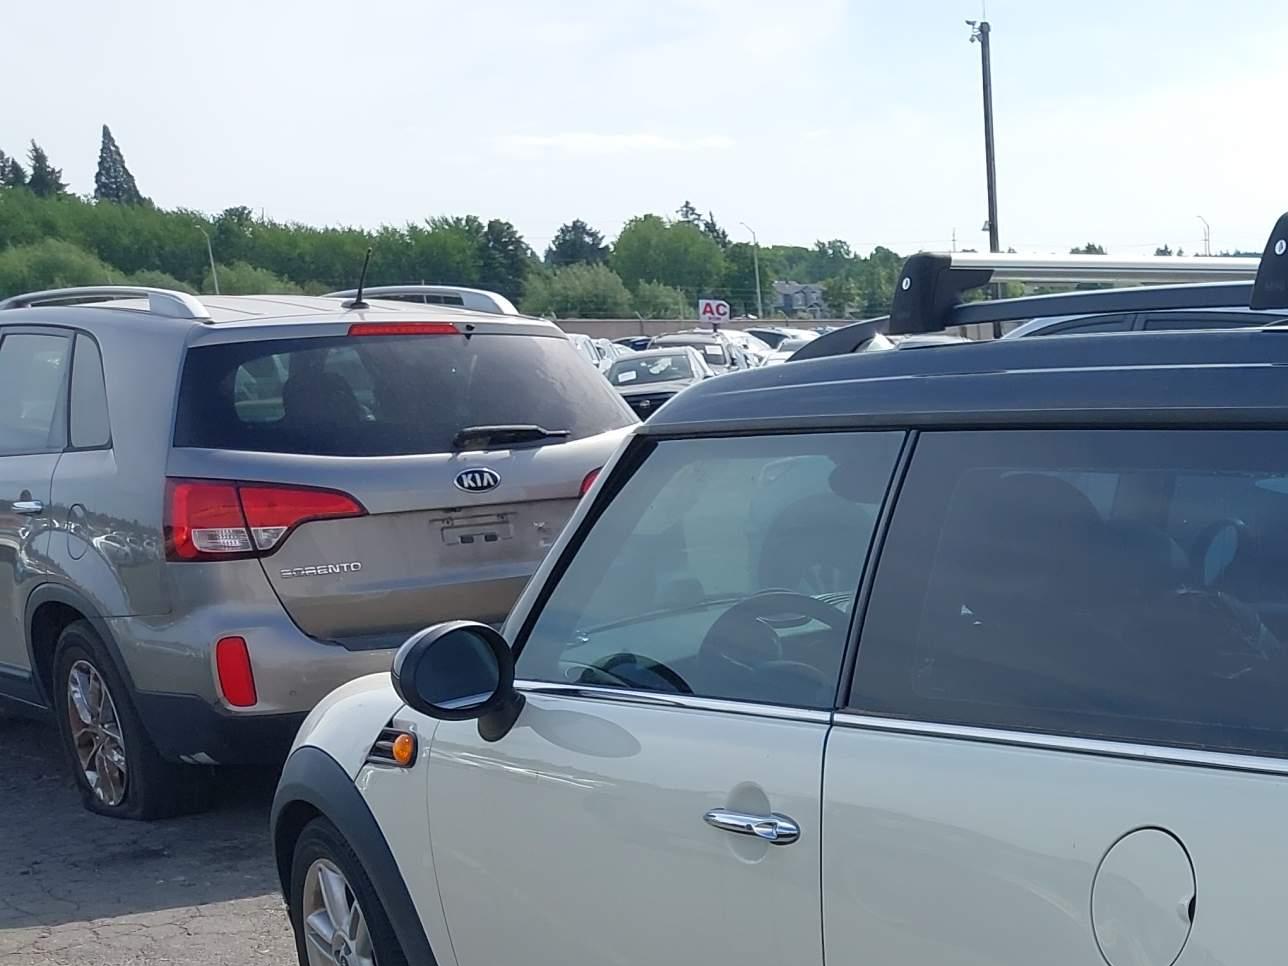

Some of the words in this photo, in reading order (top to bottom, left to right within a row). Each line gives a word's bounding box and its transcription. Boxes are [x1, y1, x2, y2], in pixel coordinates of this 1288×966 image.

[702, 302, 728, 317] AC
[461, 472, 495, 488] KIA
[279, 562, 362, 578] SORENTO
